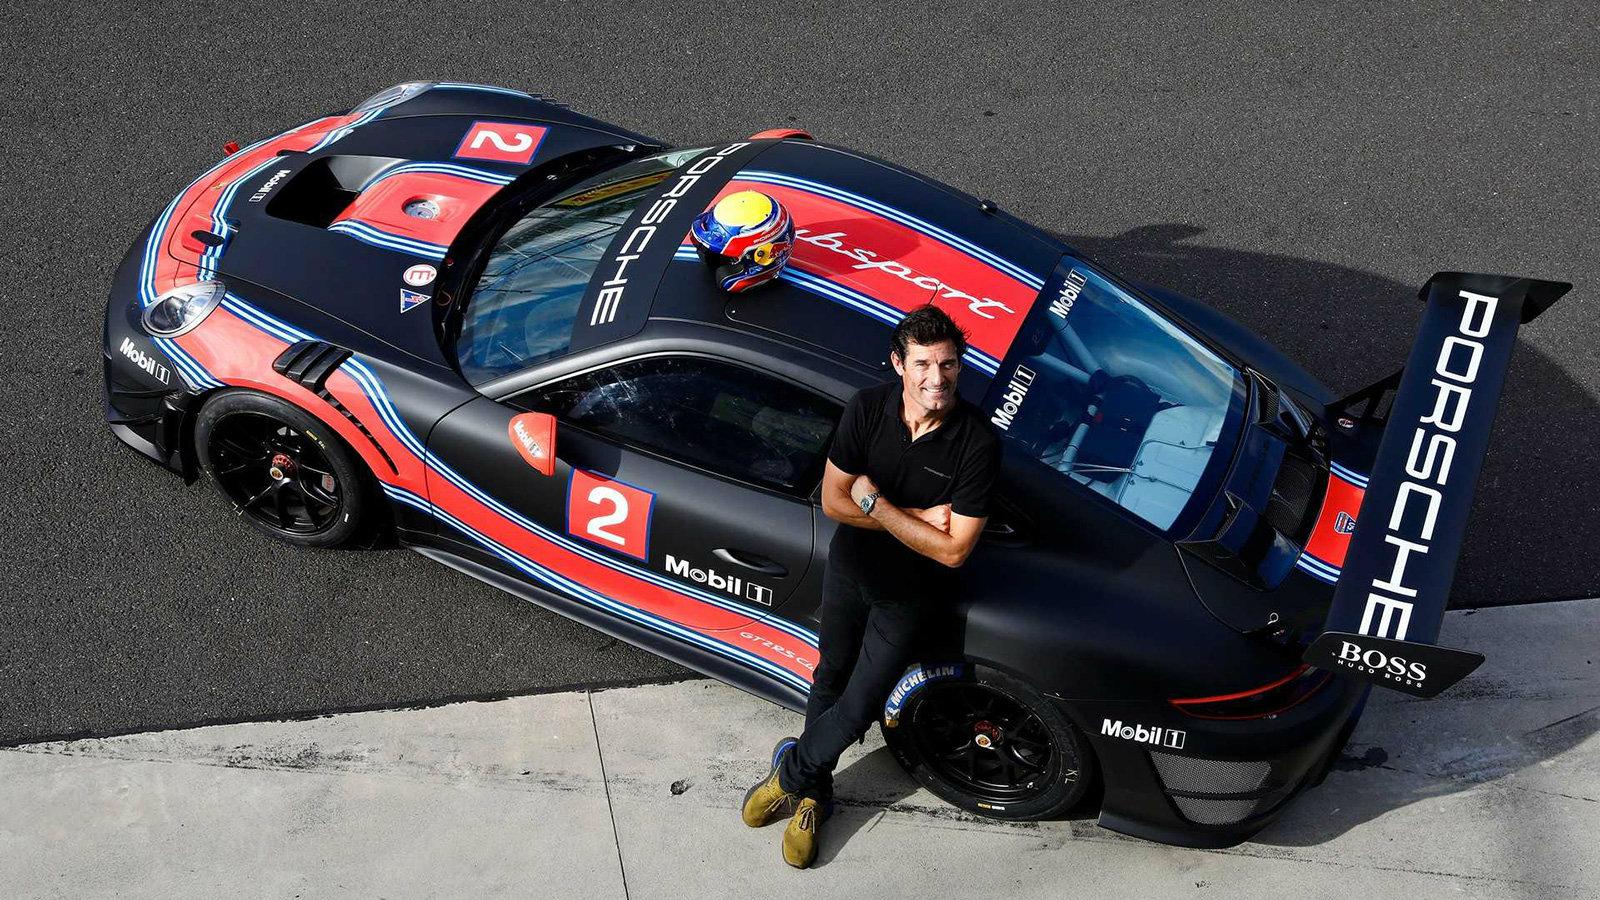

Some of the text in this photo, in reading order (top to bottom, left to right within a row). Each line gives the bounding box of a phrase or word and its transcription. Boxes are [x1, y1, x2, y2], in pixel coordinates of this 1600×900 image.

[470, 130, 533, 152] 2
[258, 169, 292, 198] Mobil
[589, 141, 752, 326] PORSCHE
[1049, 268, 1088, 319] Mobil 1
[119, 336, 171, 386] Mobil 1
[990, 364, 1037, 431] Mobil 1
[1358, 289, 1499, 641] PORSCHE
[587, 486, 629, 546] 2
[665, 554, 773, 607] Mobil 1
[1337, 659, 1422, 688] HUGO BOSS
[1338, 640, 1427, 681] BOSS
[890, 666, 955, 707] MICHELIN
[1100, 718, 1187, 750] Mobil 1
